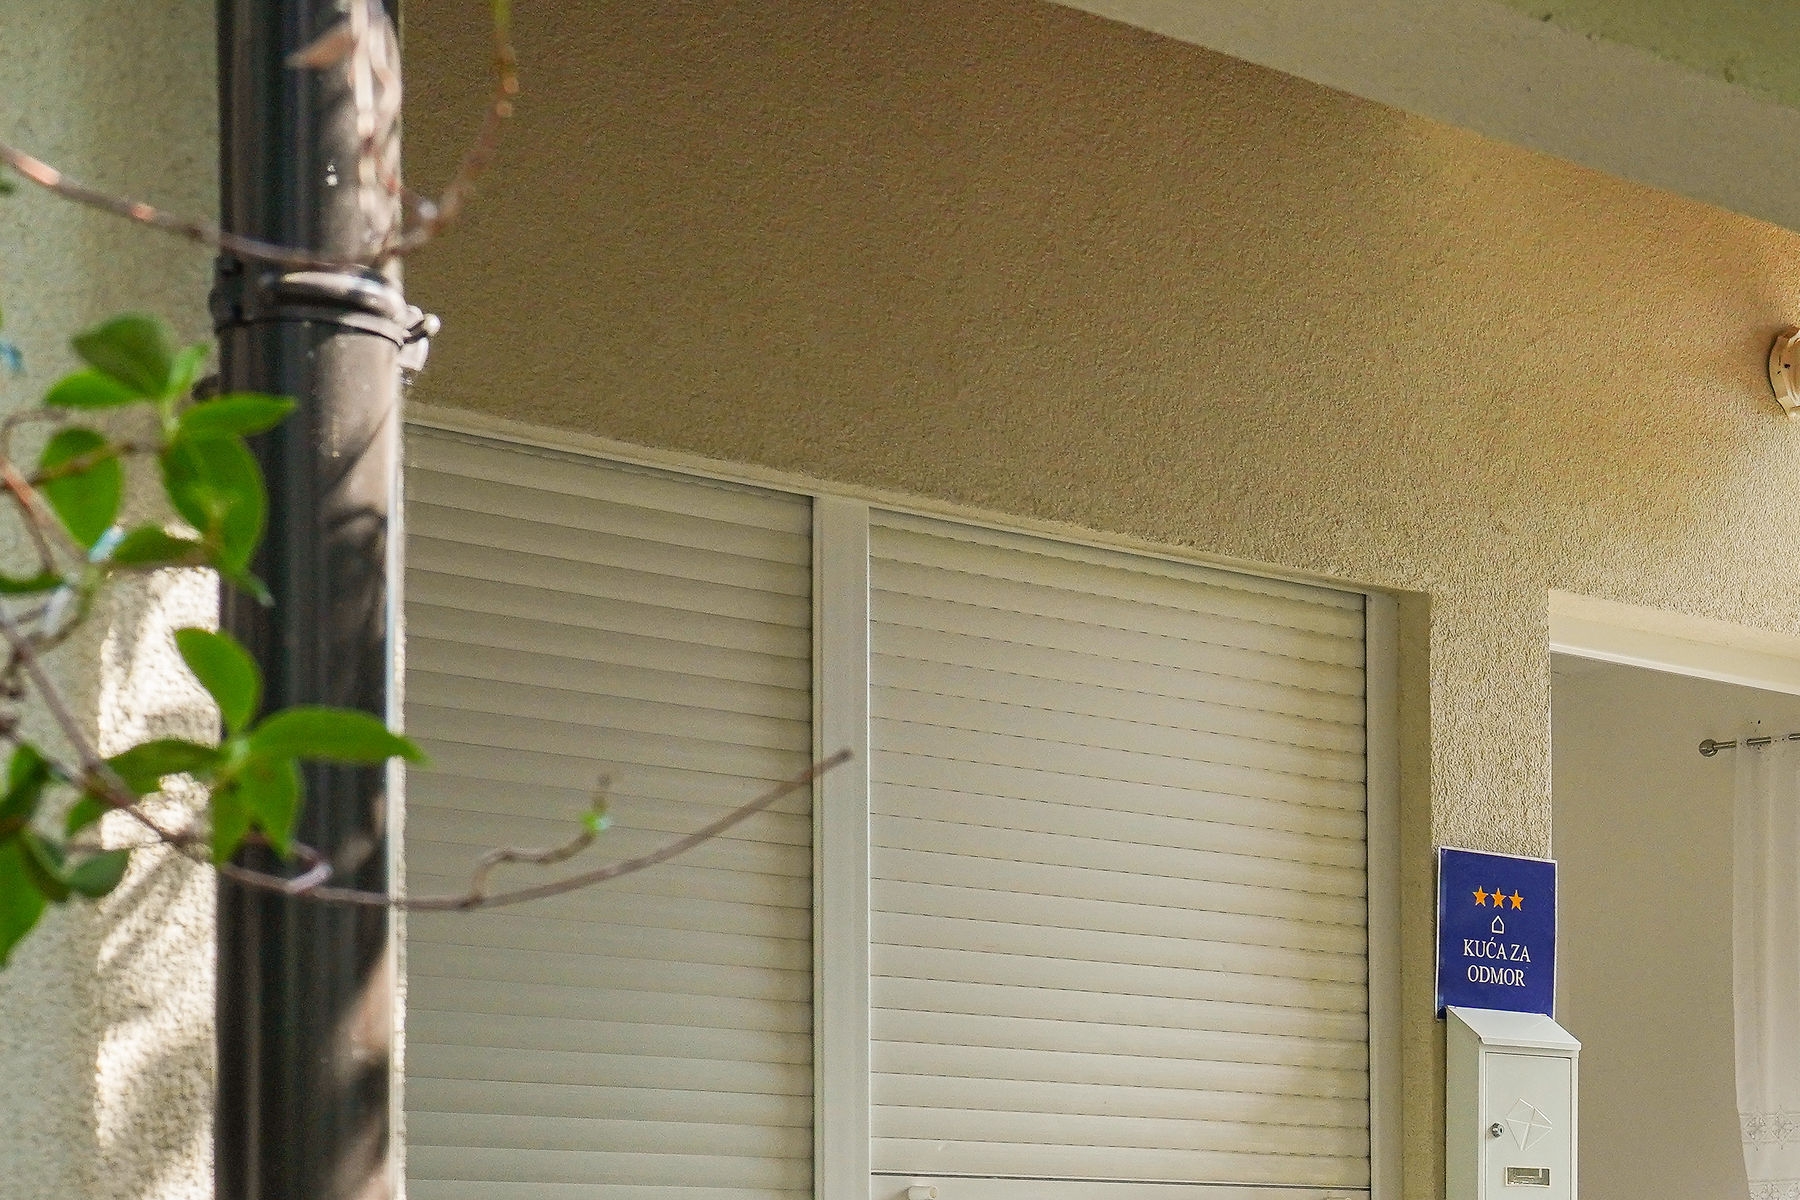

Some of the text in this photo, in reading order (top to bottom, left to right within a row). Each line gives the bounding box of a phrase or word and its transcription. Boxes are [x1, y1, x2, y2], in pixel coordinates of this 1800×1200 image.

[1463, 937, 1531, 962] KUĆA ZA
[1467, 965, 1526, 987] ODMOR
